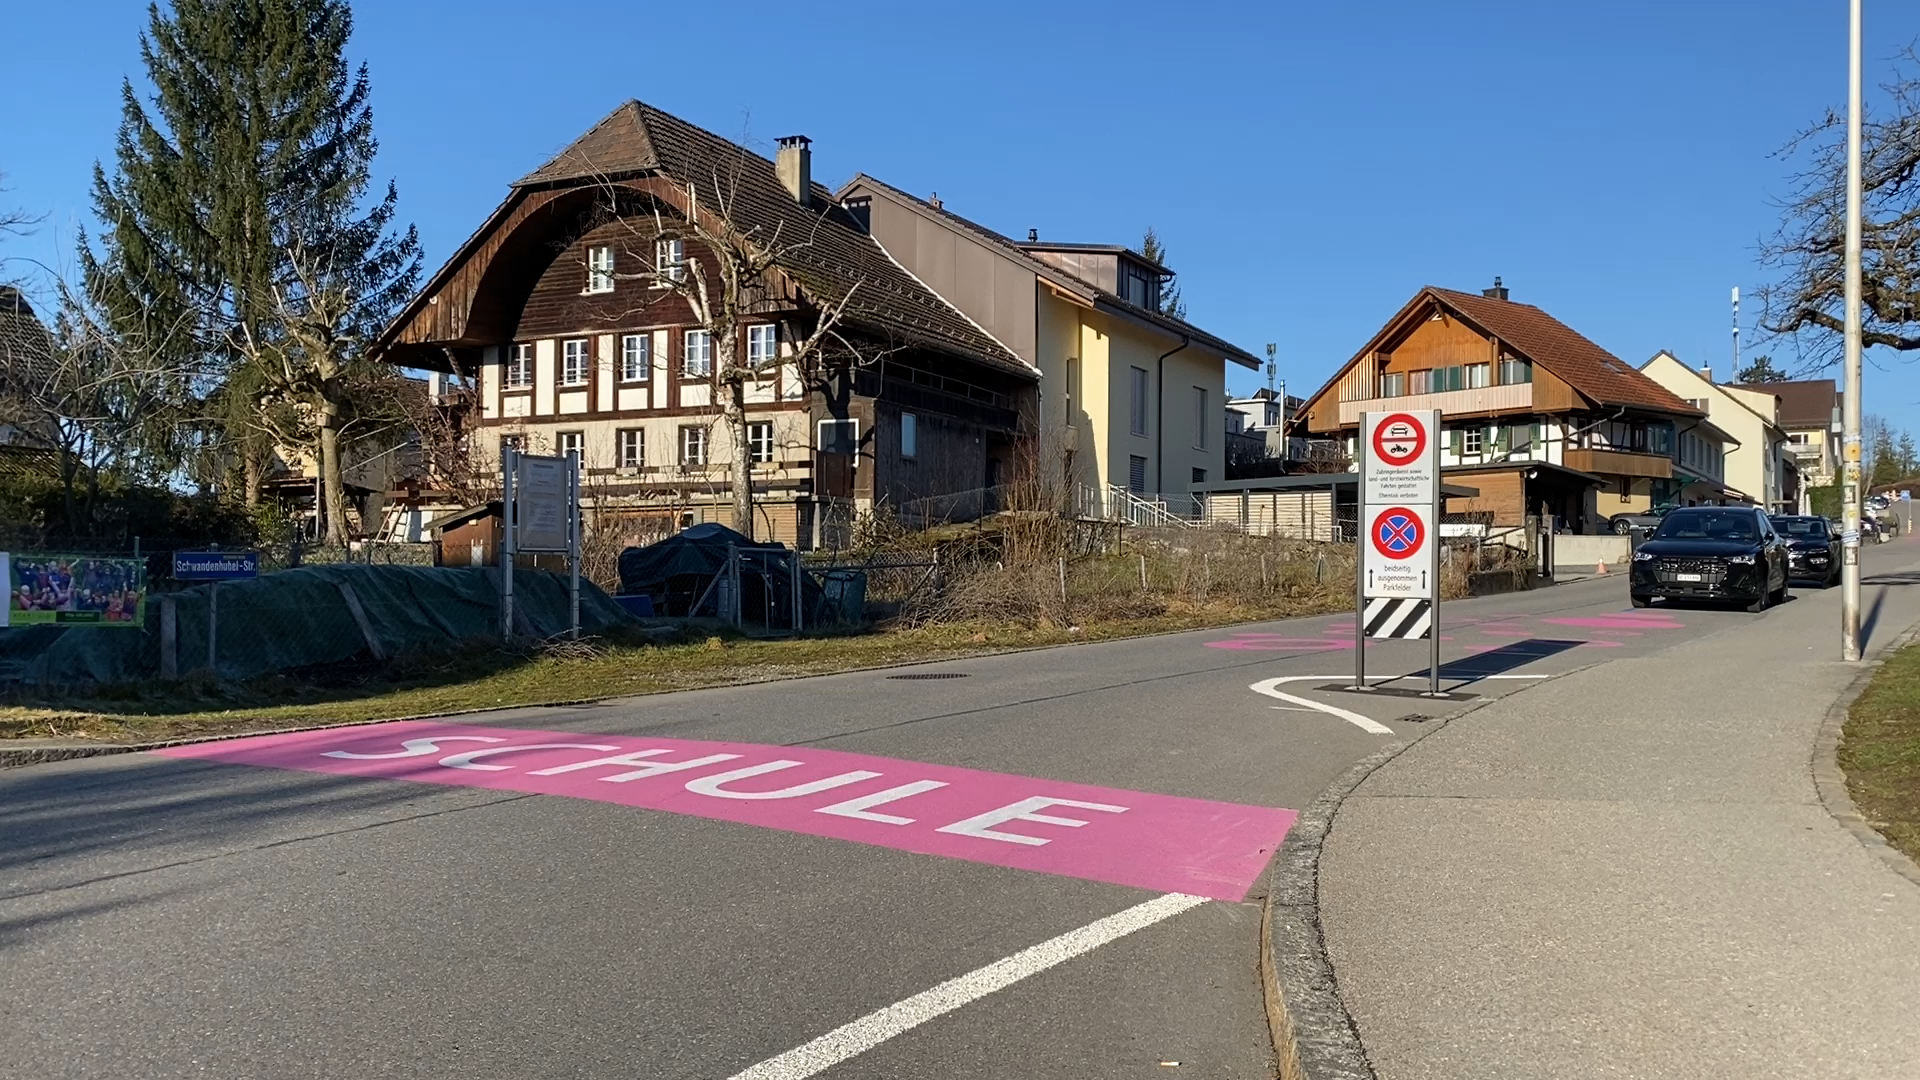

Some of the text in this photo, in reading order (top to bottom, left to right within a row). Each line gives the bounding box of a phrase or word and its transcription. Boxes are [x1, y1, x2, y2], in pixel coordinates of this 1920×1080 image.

[1384, 564, 1411, 574] beidseitig
[1377, 575, 1417, 583] ausgenommen
[1383, 583, 1412, 591] Parkfelder
[320, 736, 1130, 846] SCHULE
